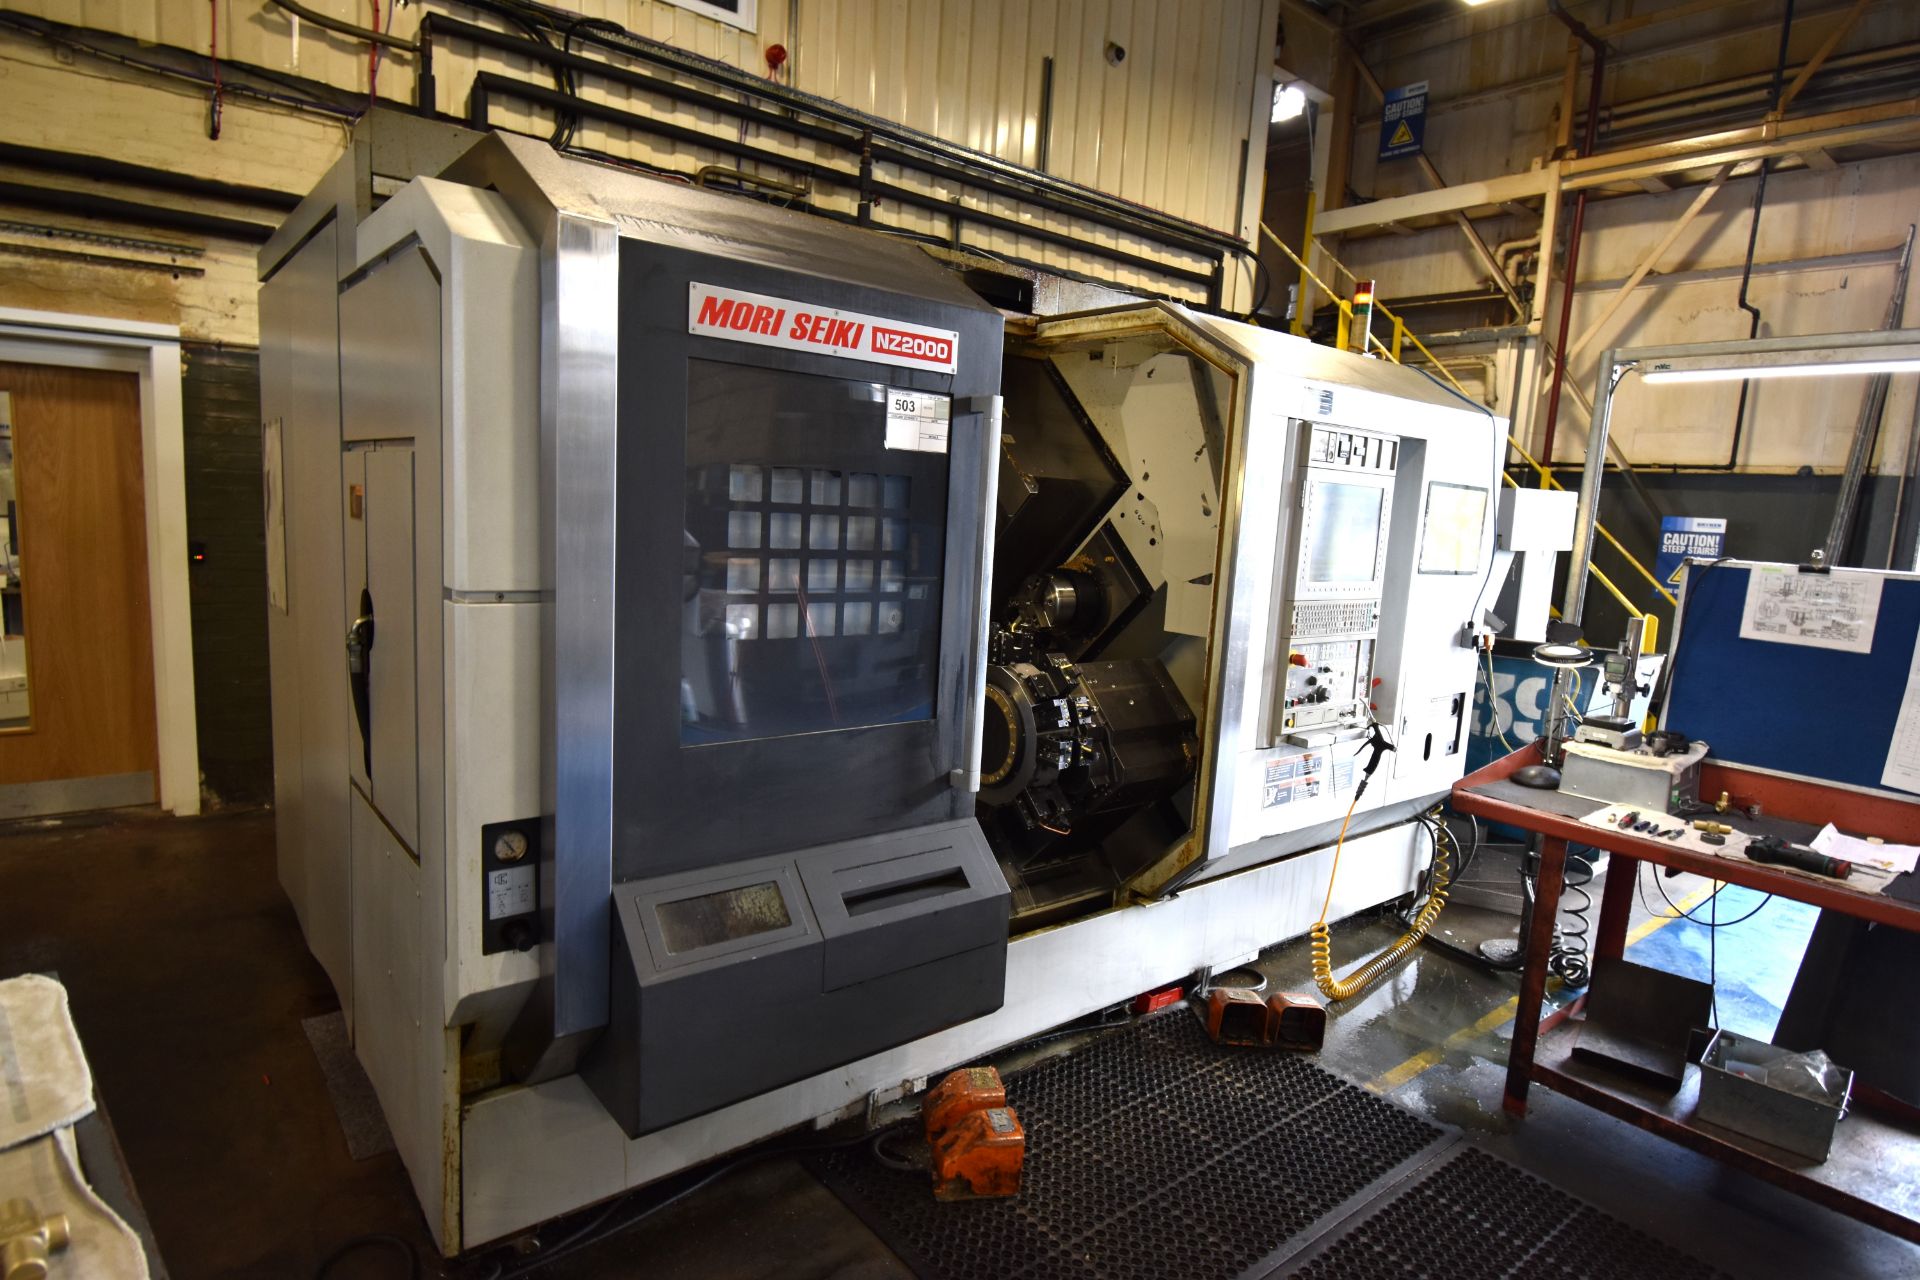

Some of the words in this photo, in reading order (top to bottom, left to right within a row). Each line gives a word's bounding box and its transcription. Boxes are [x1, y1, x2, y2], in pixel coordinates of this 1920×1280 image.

[1385, 95, 1425, 114] CAUTION!
[697, 295, 785, 337] MORI
[789, 312, 865, 350] SEIKI
[875, 332, 949, 360] NZ2000
[894, 399, 916, 413] 503
[1663, 532, 1720, 548] CAUTION!
[1662, 544, 1686, 554] STEEP
[1687, 546, 1719, 556] STAIRS!
